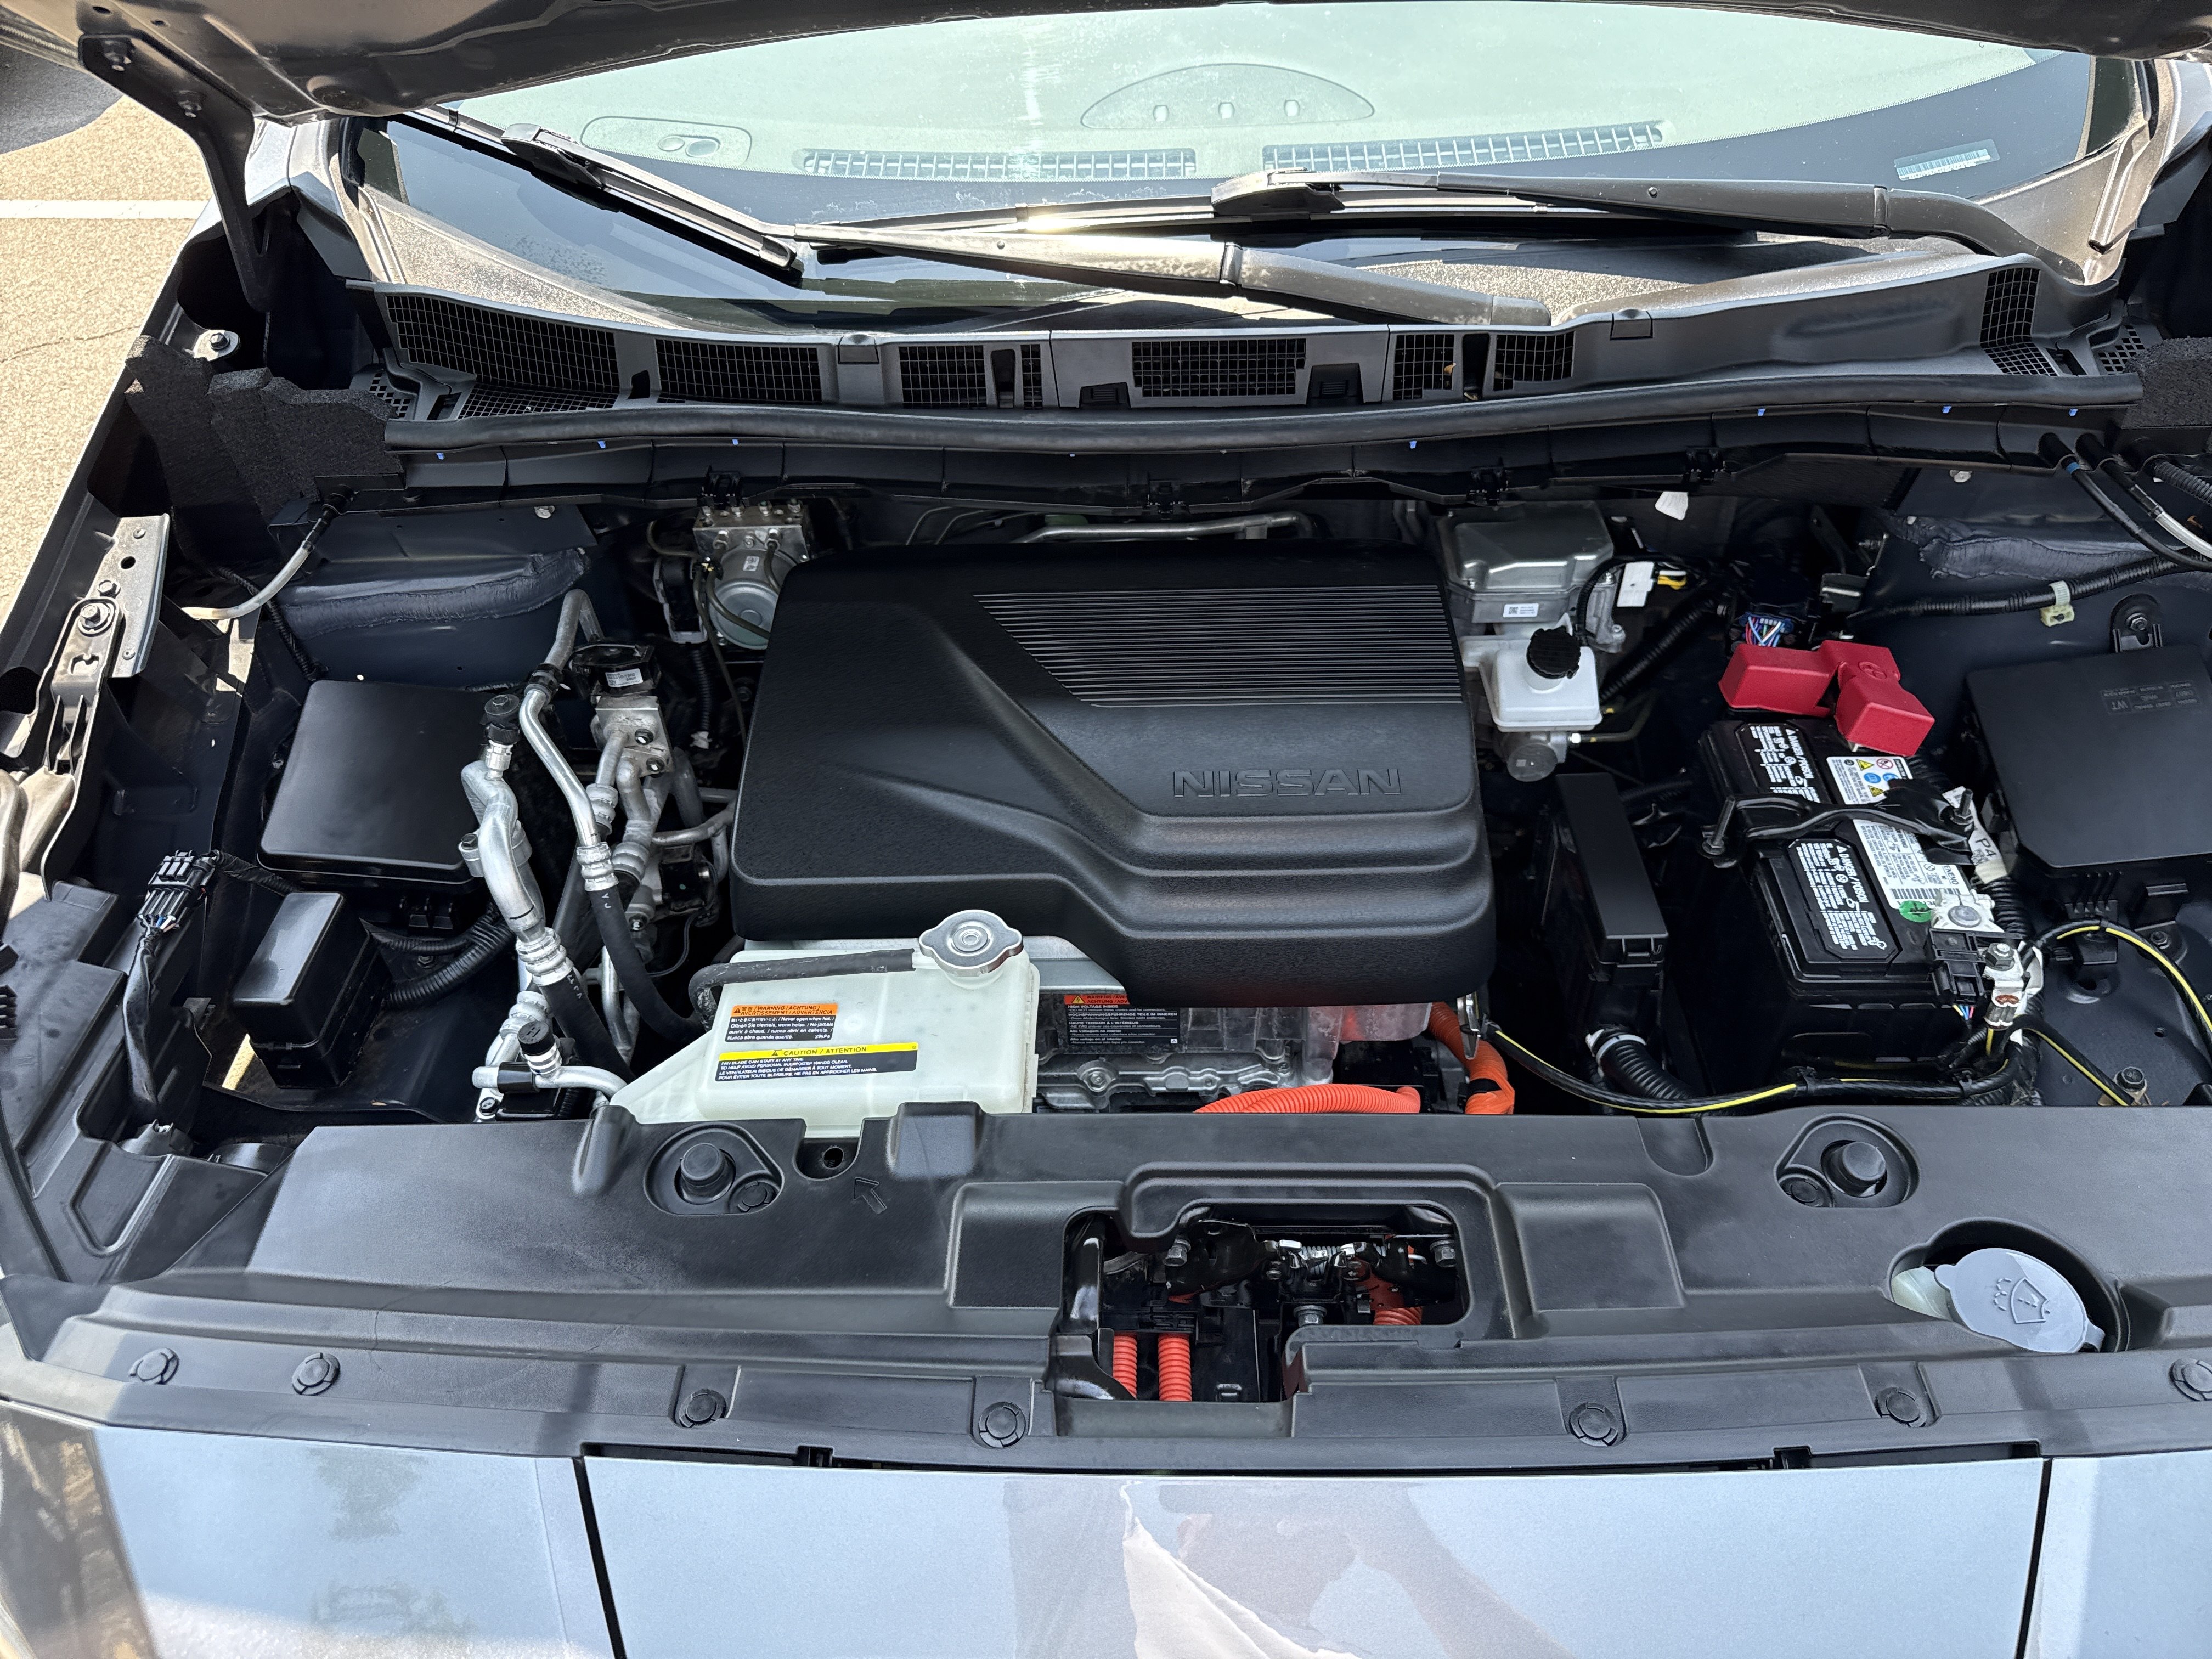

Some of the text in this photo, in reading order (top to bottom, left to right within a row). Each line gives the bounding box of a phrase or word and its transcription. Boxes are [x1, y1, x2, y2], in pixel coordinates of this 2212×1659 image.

[1788, 736, 1814, 778] DANGER/POISON
[1173, 769, 1401, 797] NISSAN
[1976, 838, 1996, 857] P4
[1839, 854, 1869, 902] DANGER/POISON
[1944, 865, 1959, 885] ENENO
